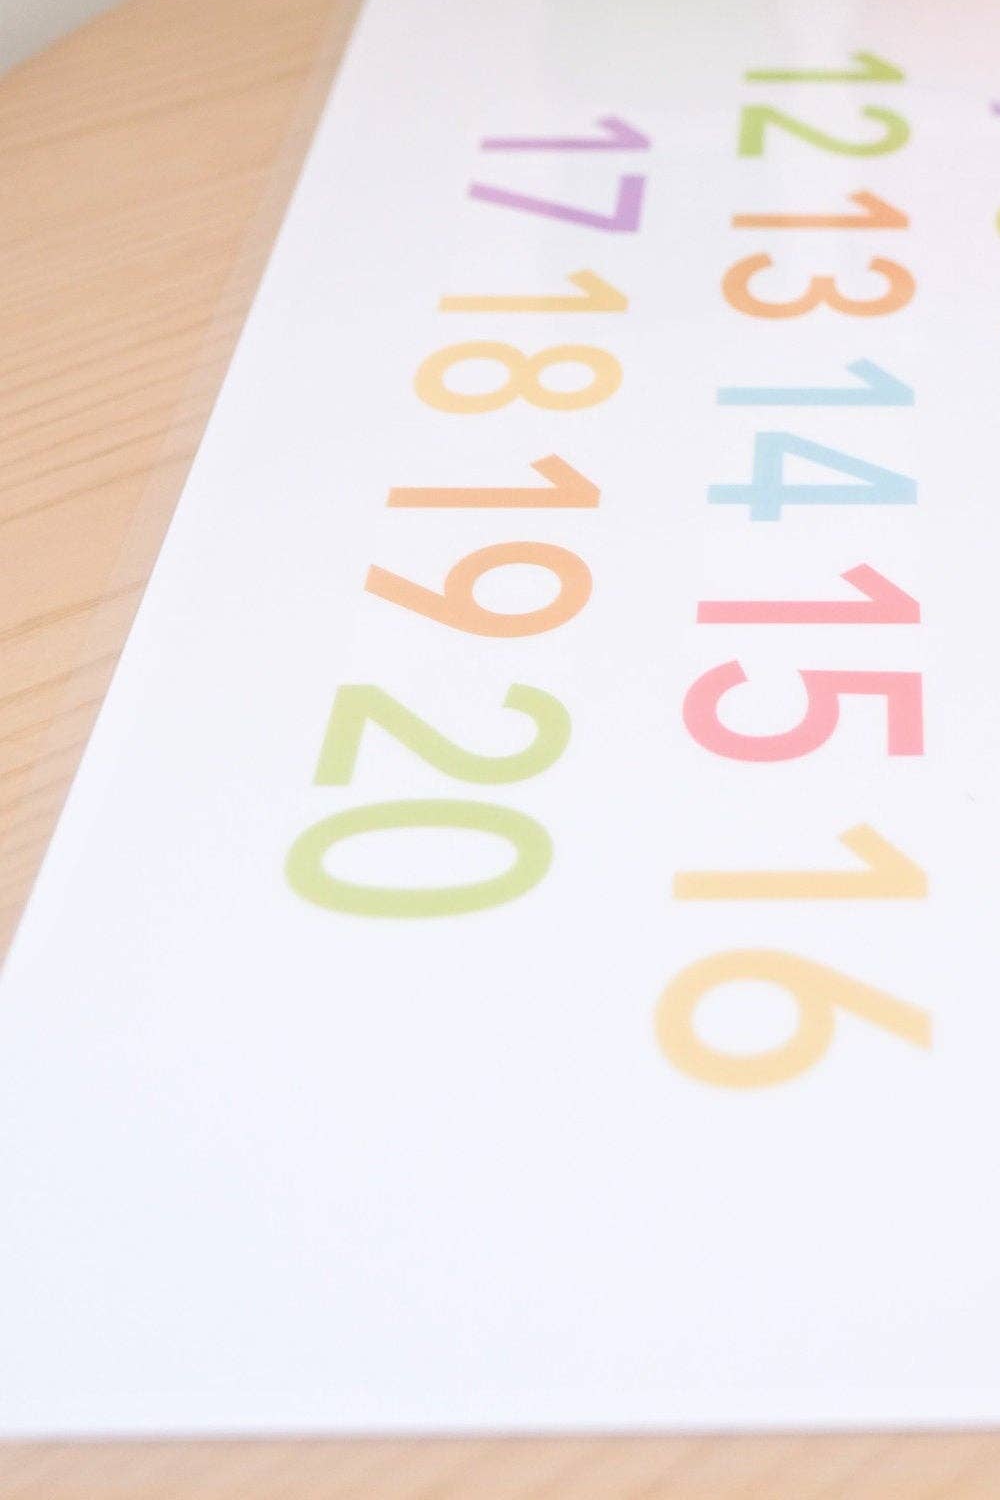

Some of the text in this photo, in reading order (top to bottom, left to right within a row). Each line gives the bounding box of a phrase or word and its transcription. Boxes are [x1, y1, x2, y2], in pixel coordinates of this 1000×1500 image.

[286, 114, 652, 918] 17 18 19 20
[655, 52, 931, 1089] 12 13 14 15 16
